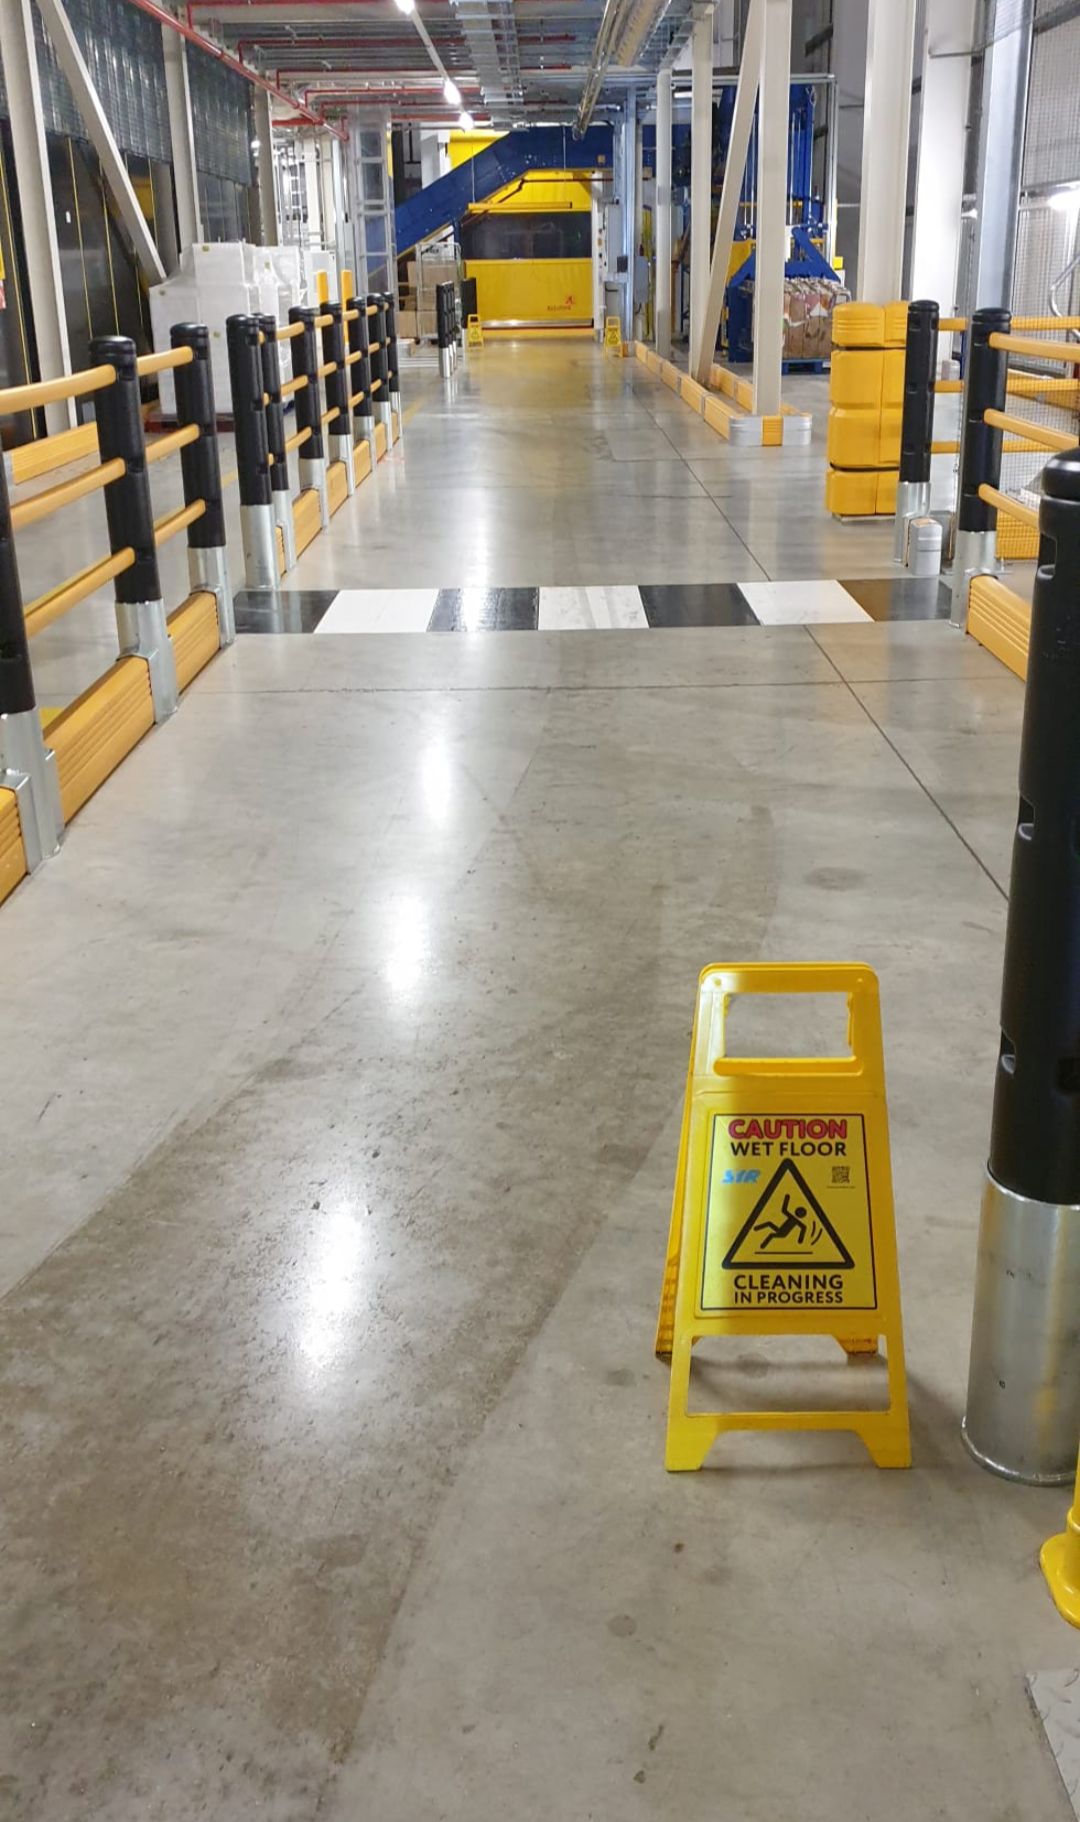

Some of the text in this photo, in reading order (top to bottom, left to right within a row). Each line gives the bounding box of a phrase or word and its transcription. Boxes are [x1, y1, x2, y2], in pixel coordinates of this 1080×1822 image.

[728, 1118, 847, 1139] CAUTION
[730, 1142, 847, 1156] WET FLOOR
[734, 1274, 844, 1290] CLEANING
[734, 1291, 844, 1304] IN PROGRESS
